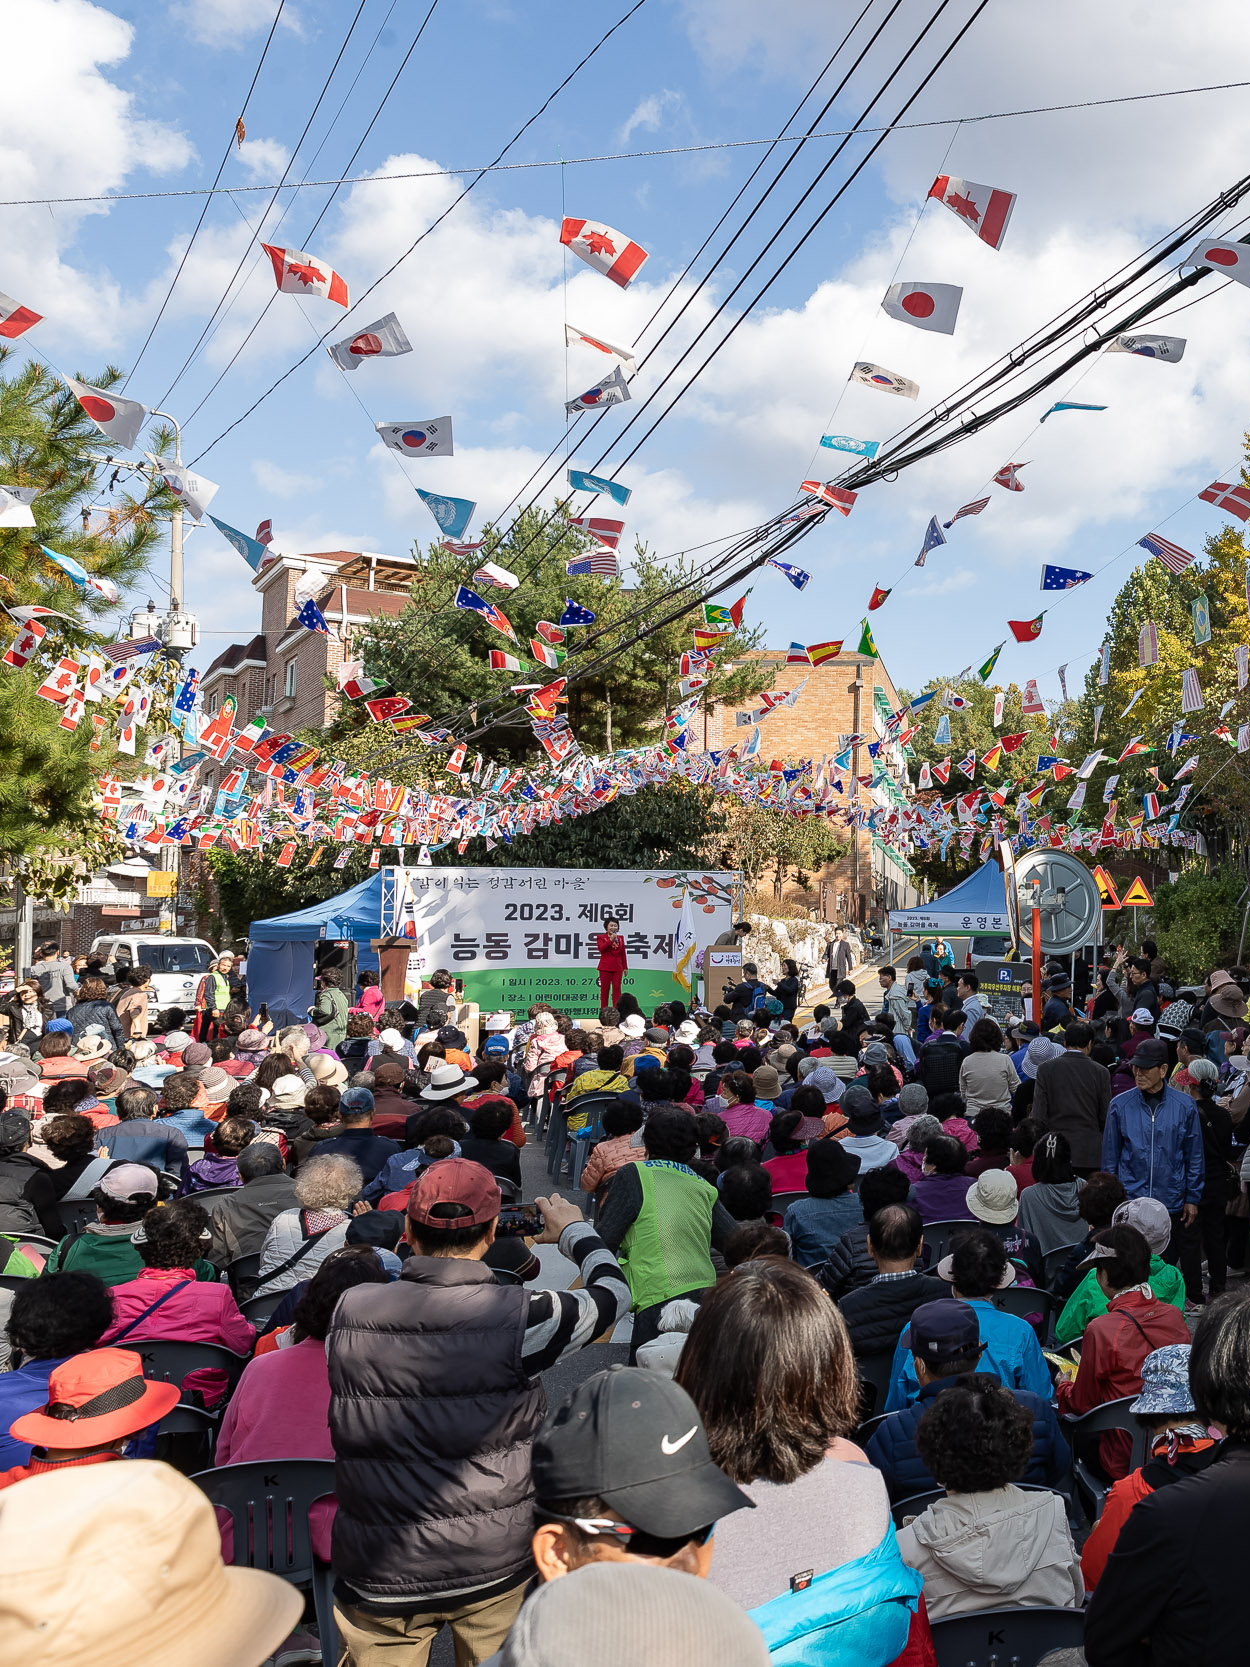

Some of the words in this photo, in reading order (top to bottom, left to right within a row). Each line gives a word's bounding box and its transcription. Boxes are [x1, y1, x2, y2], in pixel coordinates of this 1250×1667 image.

[453, 876, 480, 890] 익는
[487, 876, 548, 890] 정감어린
[504, 903, 571, 921] 2023.
[577, 903, 634, 923] 제6회
[450, 932, 512, 960] 능동
[535, 978, 563, 986] 2023.
[565, 978, 579, 986] 10.
[535, 993, 588, 1002] 어린이대공원
